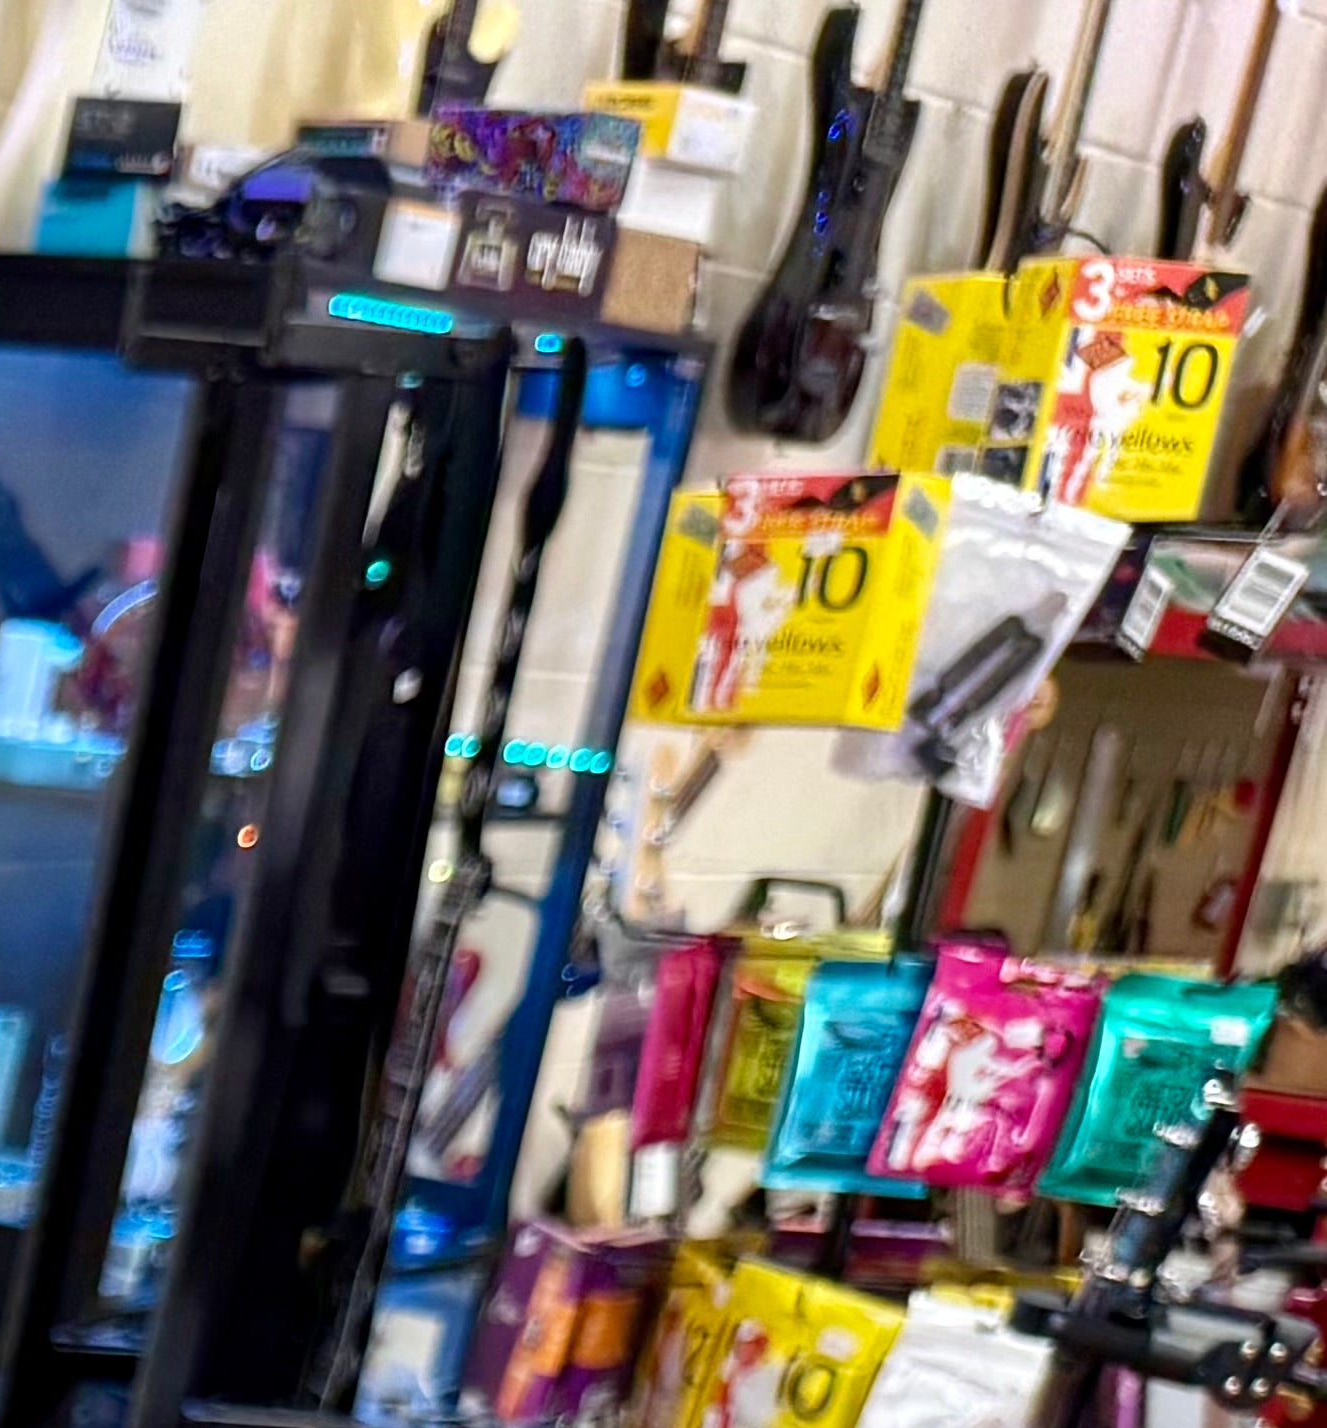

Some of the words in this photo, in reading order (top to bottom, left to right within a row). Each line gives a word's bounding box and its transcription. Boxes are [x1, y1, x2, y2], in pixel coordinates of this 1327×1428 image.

[1073, 260, 1115, 321] 3
[1150, 338, 1219, 410] 10
[797, 545, 869, 613] 10
